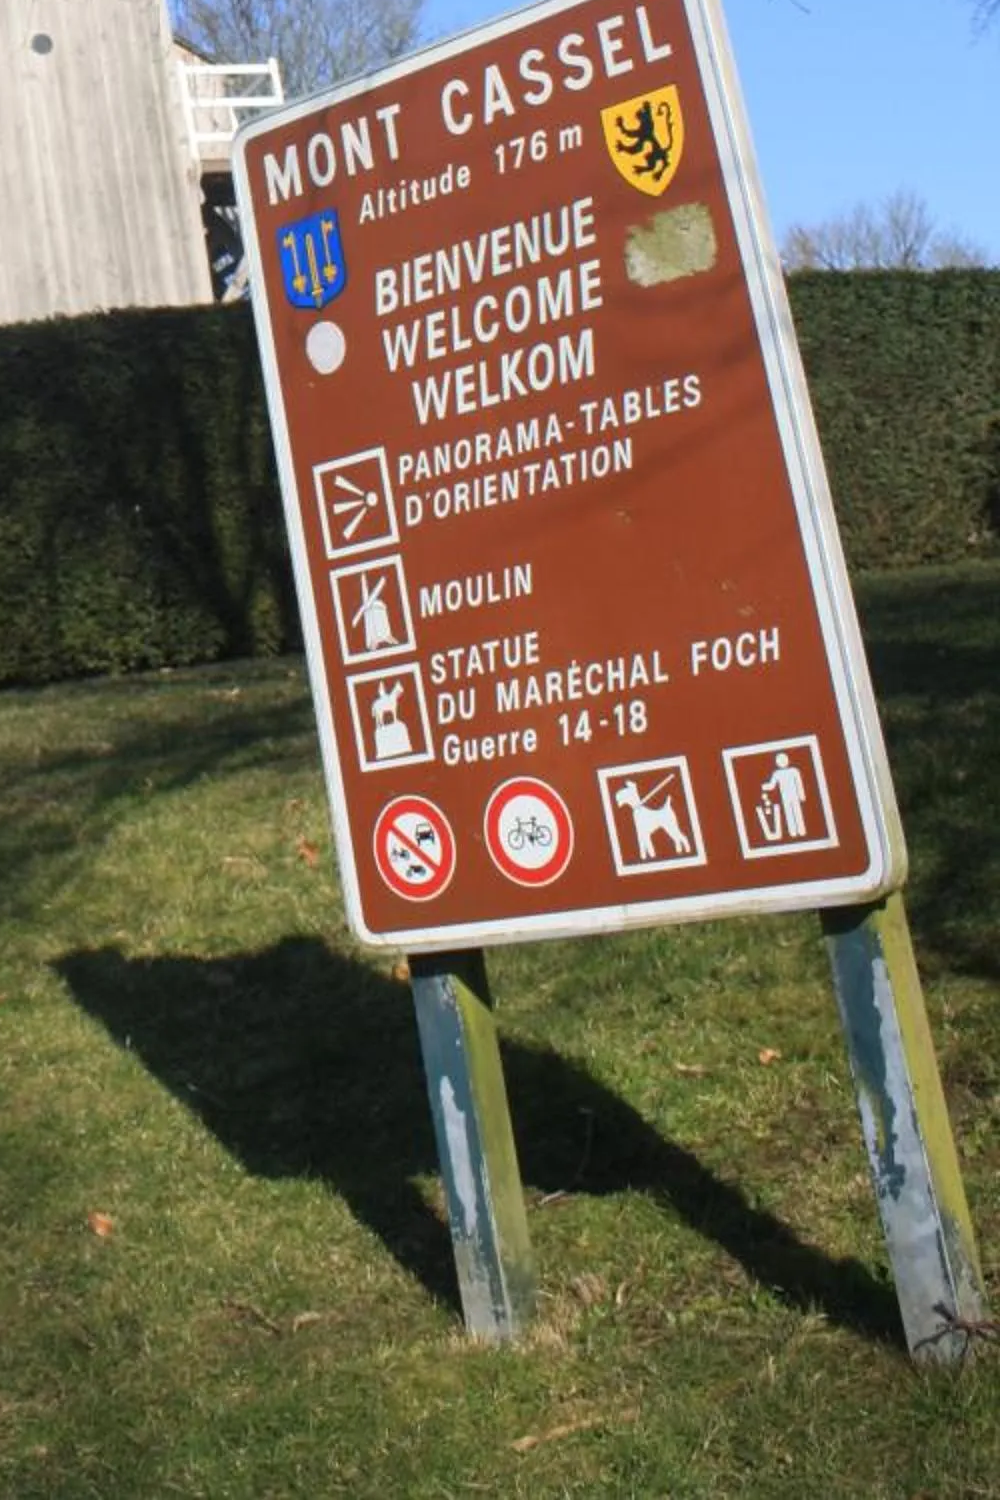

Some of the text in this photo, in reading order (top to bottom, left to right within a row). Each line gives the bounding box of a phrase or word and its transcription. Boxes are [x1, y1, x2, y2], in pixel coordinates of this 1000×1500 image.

[263, 5, 673, 206] MONT CASSEL
[359, 124, 583, 224] Altitude 176 m
[375, 196, 596, 317] BIENVENUE
[381, 259, 603, 373] WELCOME
[411, 328, 595, 425] WELKOM
[405, 437, 633, 527] D'ORIENTATION
[419, 563, 532, 618] MOULIN
[430, 631, 540, 685] STATUE
[437, 627, 780, 725] DU MARÉCHAL FOCH
[442, 699, 648, 766] Guerre 14-18
